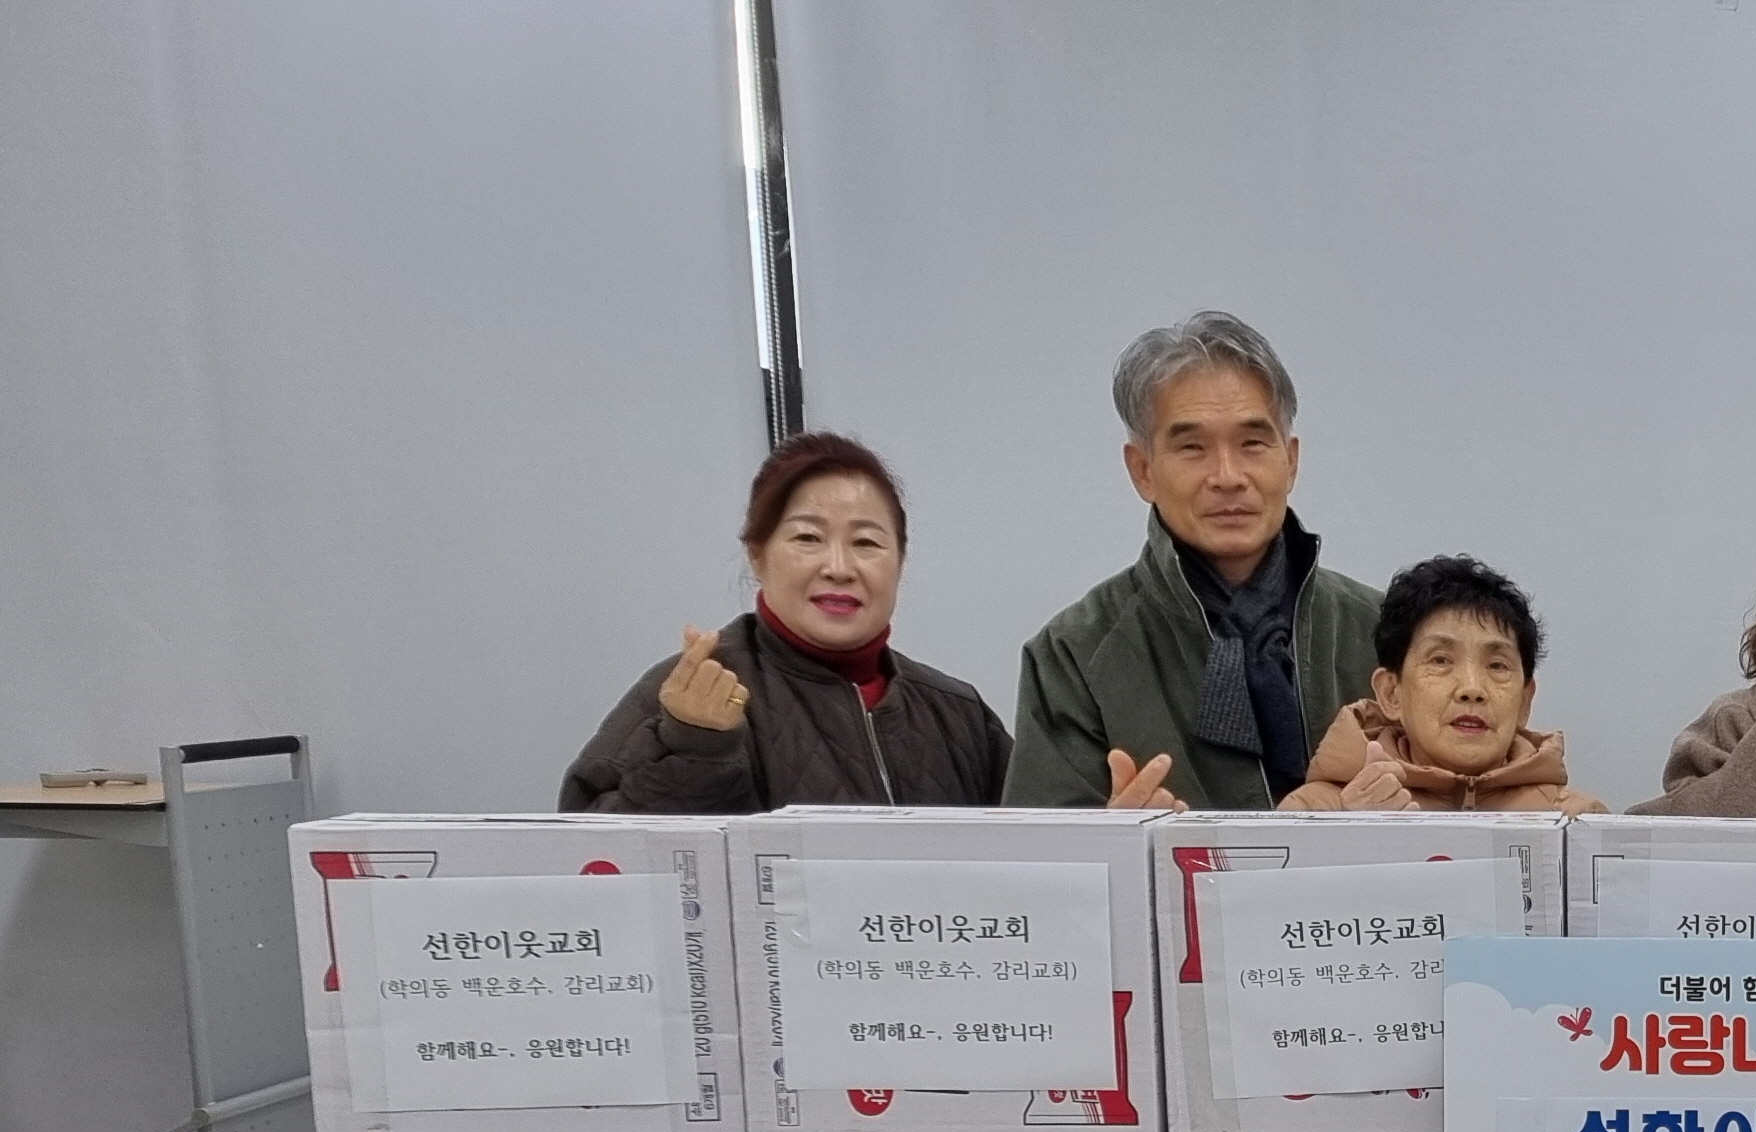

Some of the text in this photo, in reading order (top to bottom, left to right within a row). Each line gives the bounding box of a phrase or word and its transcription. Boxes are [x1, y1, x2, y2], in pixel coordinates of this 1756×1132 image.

[858, 913, 1030, 944] 선한이웃교회
[1279, 912, 1444, 950] 선한이웃교회
[421, 927, 603, 961] 선한이웃교회
[1659, 974, 1732, 1003] 더불어
[524, 1036, 632, 1059] 응원합니다!
[951, 1022, 1053, 1043] 응원합니다!
